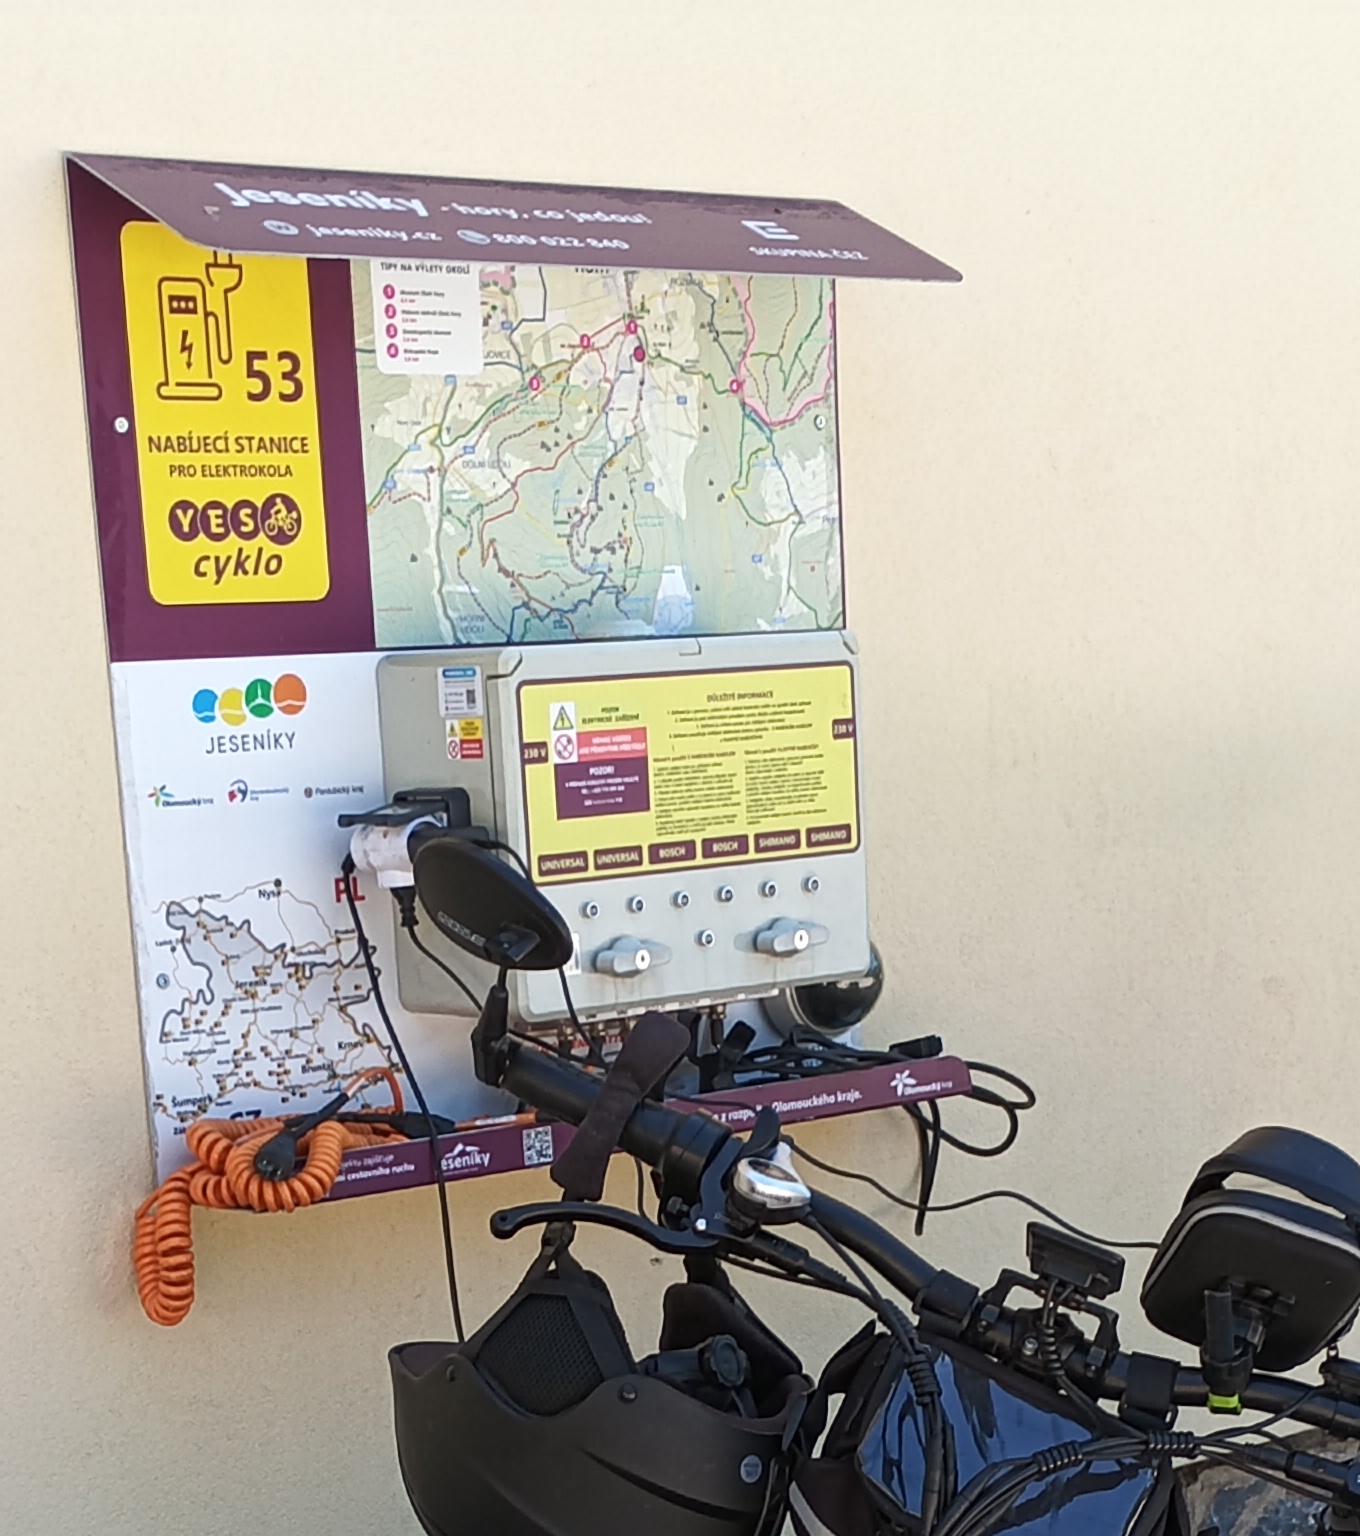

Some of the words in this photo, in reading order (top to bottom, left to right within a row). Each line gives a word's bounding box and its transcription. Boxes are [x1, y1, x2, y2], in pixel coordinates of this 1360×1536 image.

[533, 209, 564, 220] co
[380, 262, 398, 271] TIPY
[400, 263, 412, 272] NA
[415, 263, 443, 273] VÝLETY
[446, 264, 470, 274] OKOLÍ
[245, 350, 304, 402] 53
[148, 431, 230, 454] NABÍJECÍ
[235, 436, 309, 454] STANICE
[169, 464, 197, 478] PRO
[201, 463, 293, 478] ELEKTROKOLA
[175, 508, 255, 534] YES
[193, 547, 283, 585] cyklo
[205, 728, 297, 755] JESENÍKY
[524, 748, 539, 759] 230
[315, 786, 350, 796] Pardubický
[759, 835, 796, 849] SHIMANO
[811, 830, 847, 843] SHIMANO
[658, 846, 686, 859] BOSCH
[712, 841, 739, 854] BOSCH
[540, 858, 586, 871] UNIVERSAL
[596, 851, 640, 865] UNIVERSAL
[440, 1149, 491, 1171] eseníky
[347, 1166, 390, 1181] cestovního
[392, 1162, 415, 1174] ruchu
